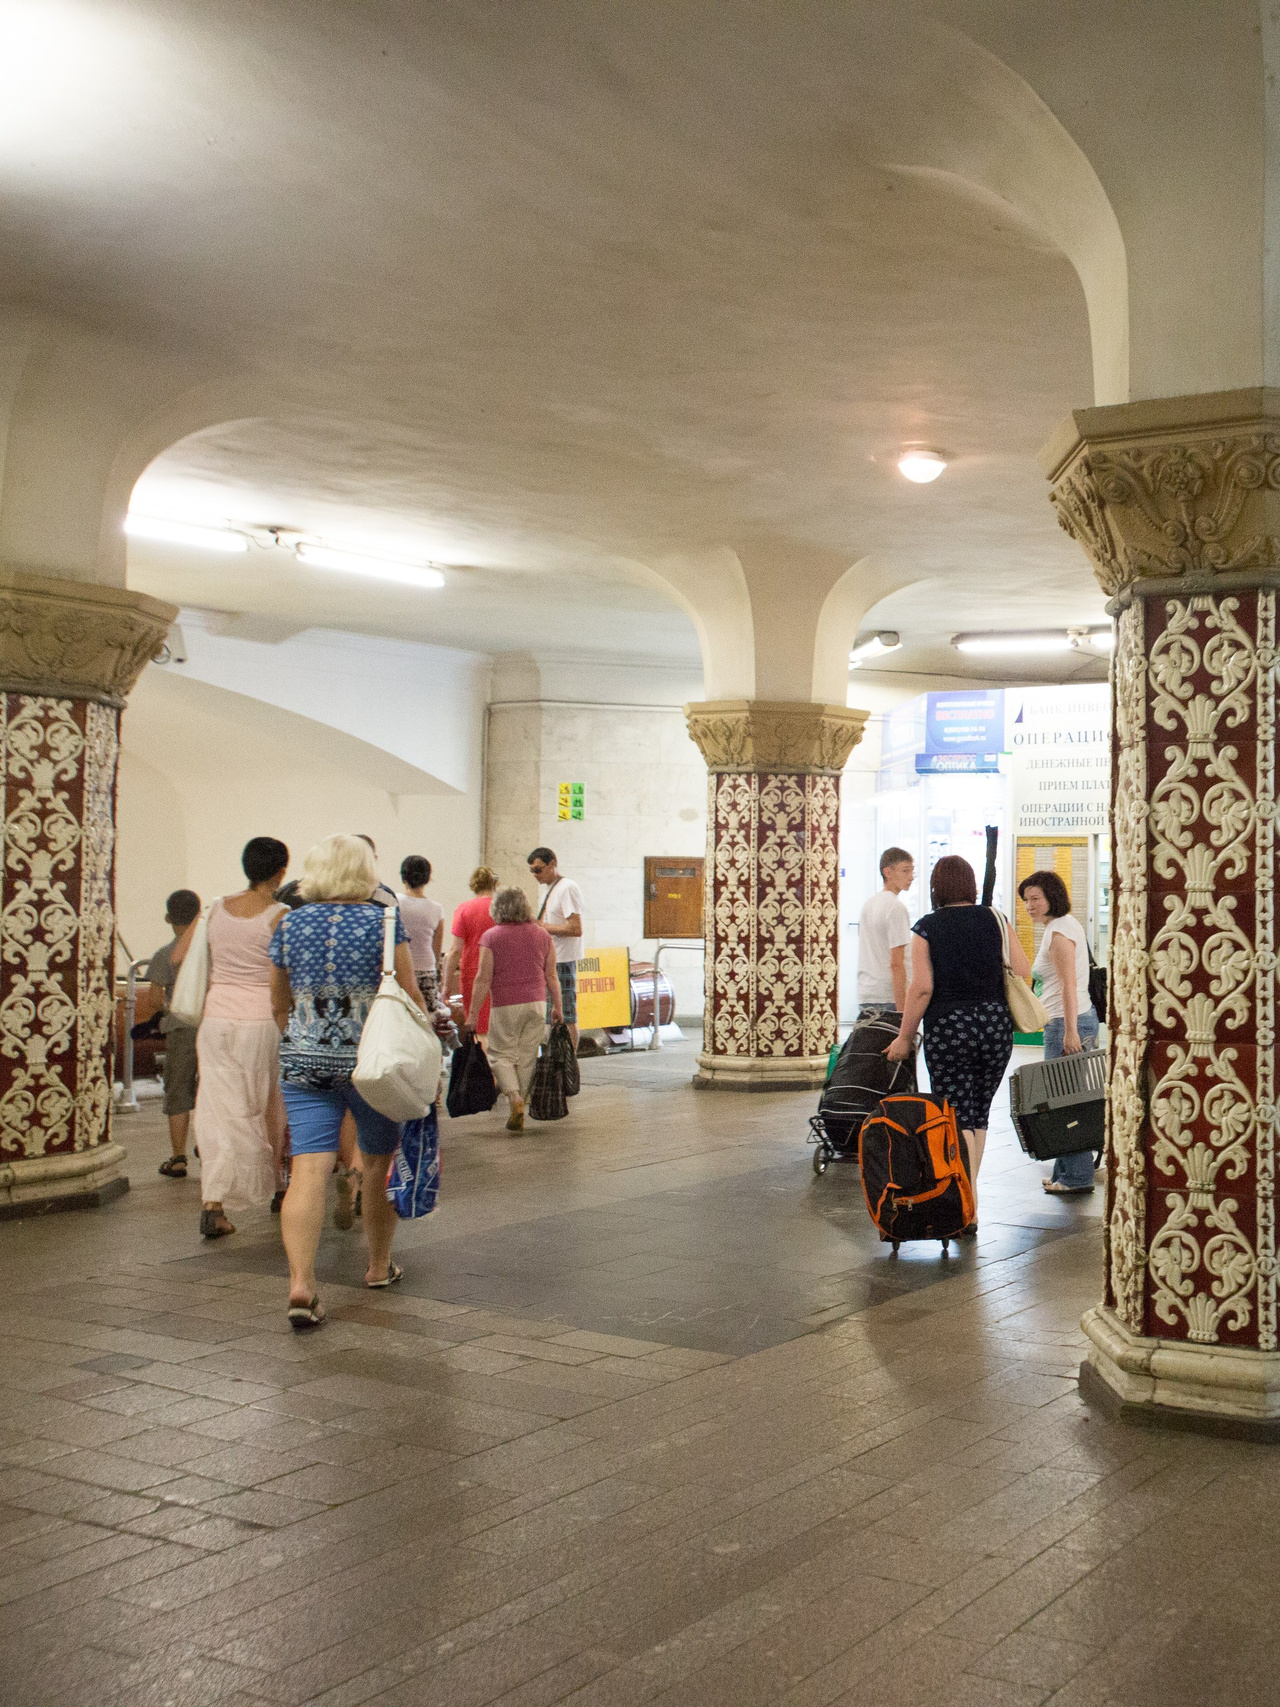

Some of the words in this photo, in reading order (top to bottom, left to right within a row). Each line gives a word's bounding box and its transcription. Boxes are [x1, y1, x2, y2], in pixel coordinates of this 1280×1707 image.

[1030, 703, 1064, 716] БАНК
[936, 761, 977, 771] ОПТИКА
[1026, 758, 1094, 770] ДЕНЕЖНЫЕ
[1039, 780, 1079, 791] ПРИЕМ
[1021, 802, 1085, 814] ОПЕРАЦИИ
[1086, 802, 1095, 812] С
[1019, 814, 1105, 826] ИНОСТРАННОЙ
[577, 957, 601, 973] ВХОД
[577, 976, 616, 994] ПРЕЩЕН
